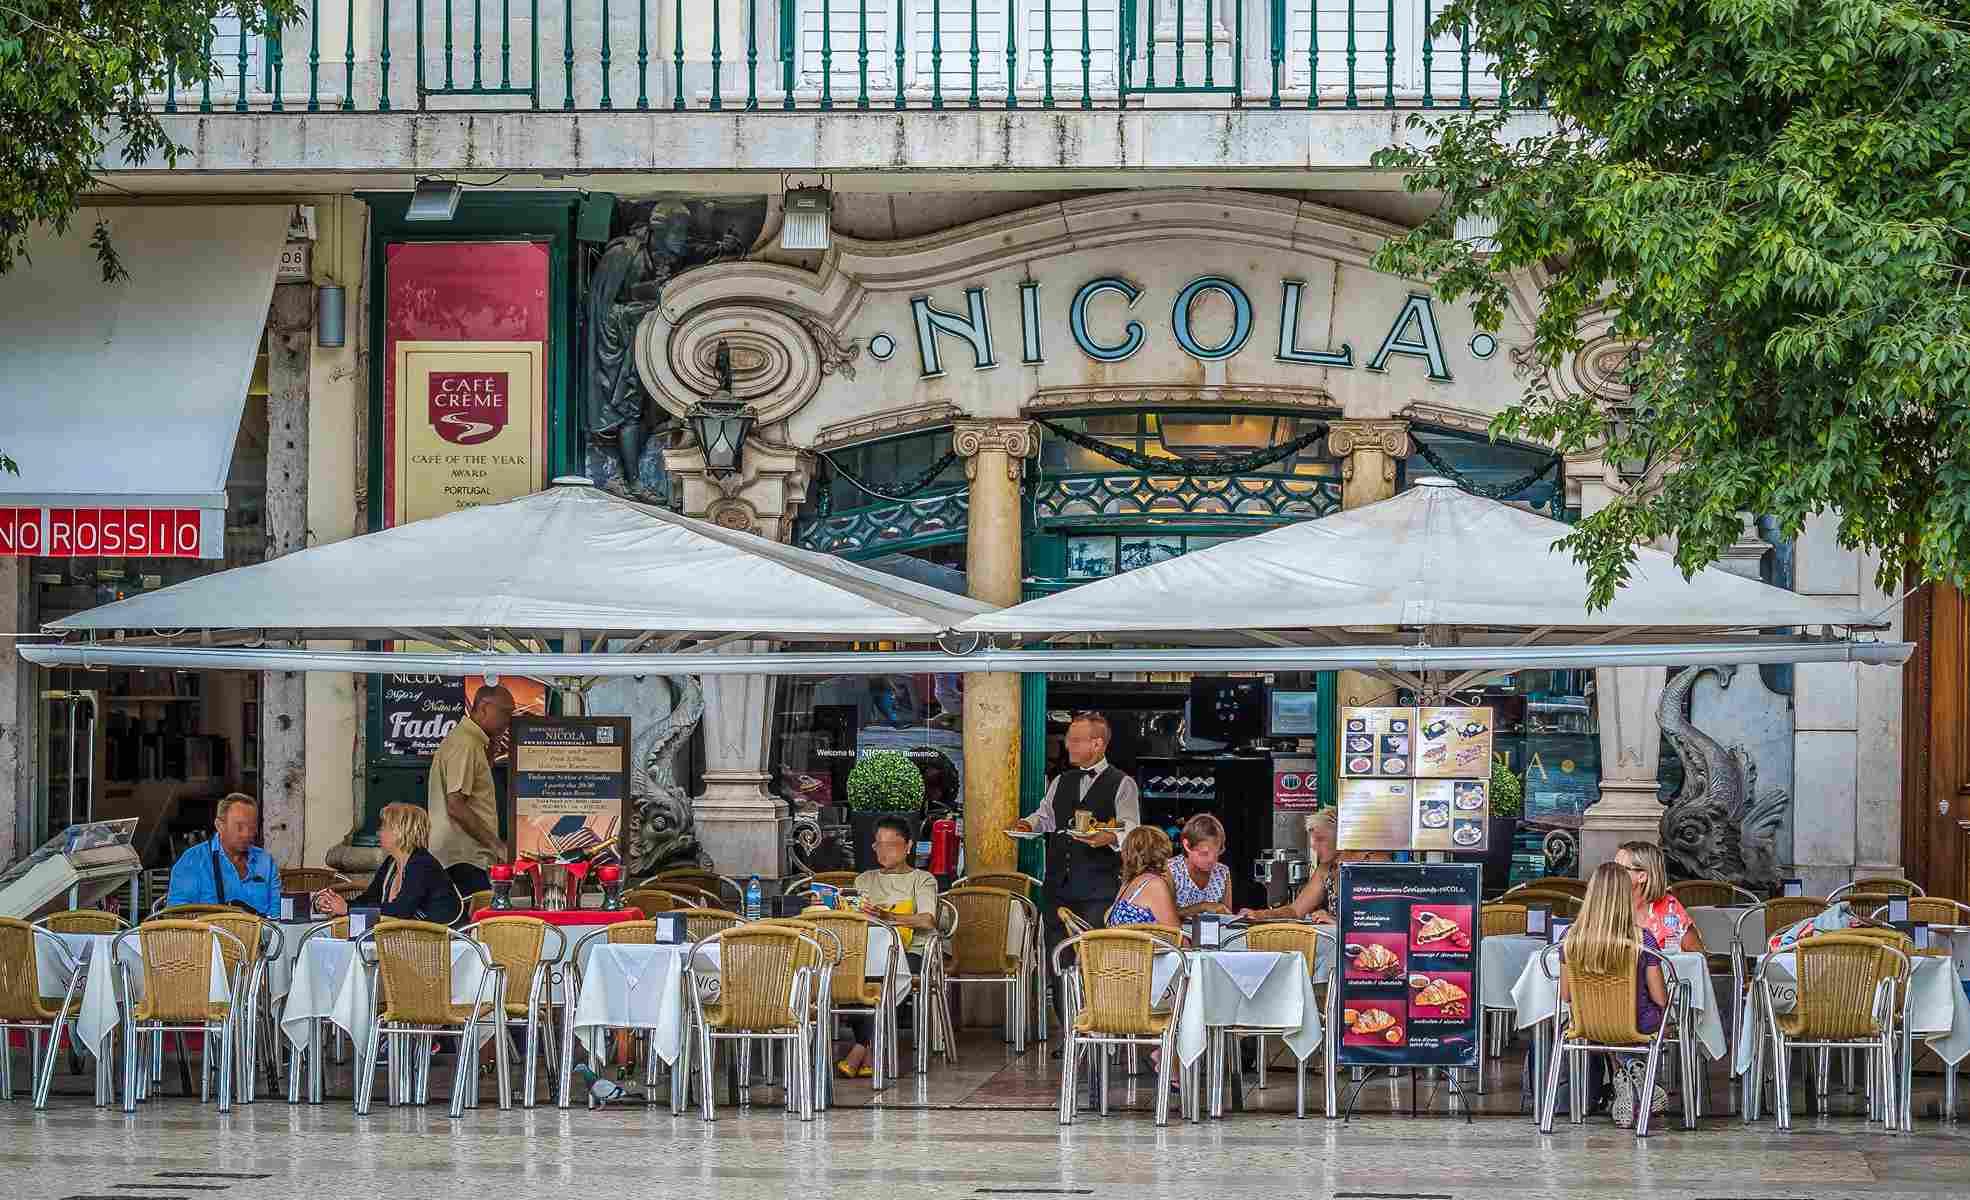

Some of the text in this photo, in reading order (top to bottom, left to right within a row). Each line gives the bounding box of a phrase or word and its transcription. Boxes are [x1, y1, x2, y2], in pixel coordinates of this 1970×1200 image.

[910, 275, 1455, 383] NICOLA
[441, 376, 497, 392] CAFÉ
[434, 391, 505, 407] CRÈME
[445, 455, 462, 465] OF
[463, 455, 487, 465] THE
[490, 455, 528, 465] YEAR
[450, 469, 488, 479] AWARD
[444, 486, 492, 496] PORTUGAL
[53, 522, 199, 550] ROSSIO
[544, 731, 587, 741] NICOLA
[816, 749, 847, 757] Welcome
